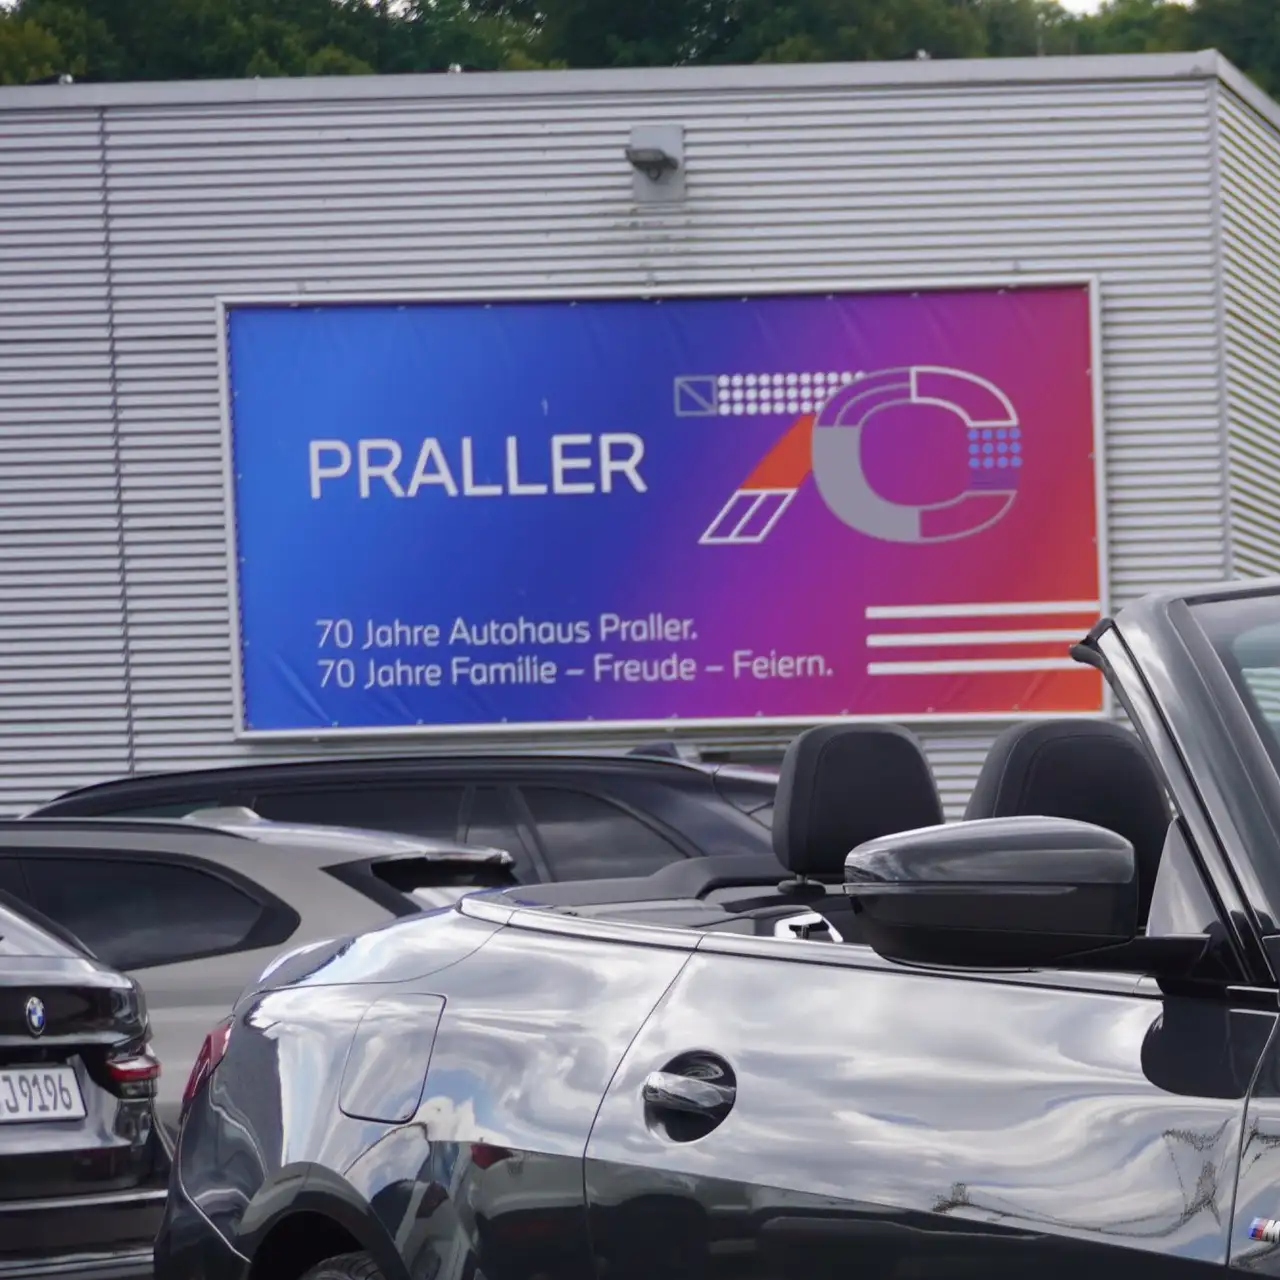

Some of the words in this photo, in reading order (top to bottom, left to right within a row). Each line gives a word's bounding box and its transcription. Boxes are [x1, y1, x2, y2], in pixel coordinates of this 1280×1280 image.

[308, 432, 648, 499] PRALLER
[315, 618, 354, 649] 70
[362, 618, 441, 651] Jahre
[448, 615, 592, 647] Autohaus
[599, 612, 698, 643] Praller.
[317, 658, 355, 689] 70
[364, 658, 443, 690] Jahre
[451, 655, 558, 687] Familie
[593, 652, 697, 683] Freude
[733, 648, 834, 680] Feiern.
